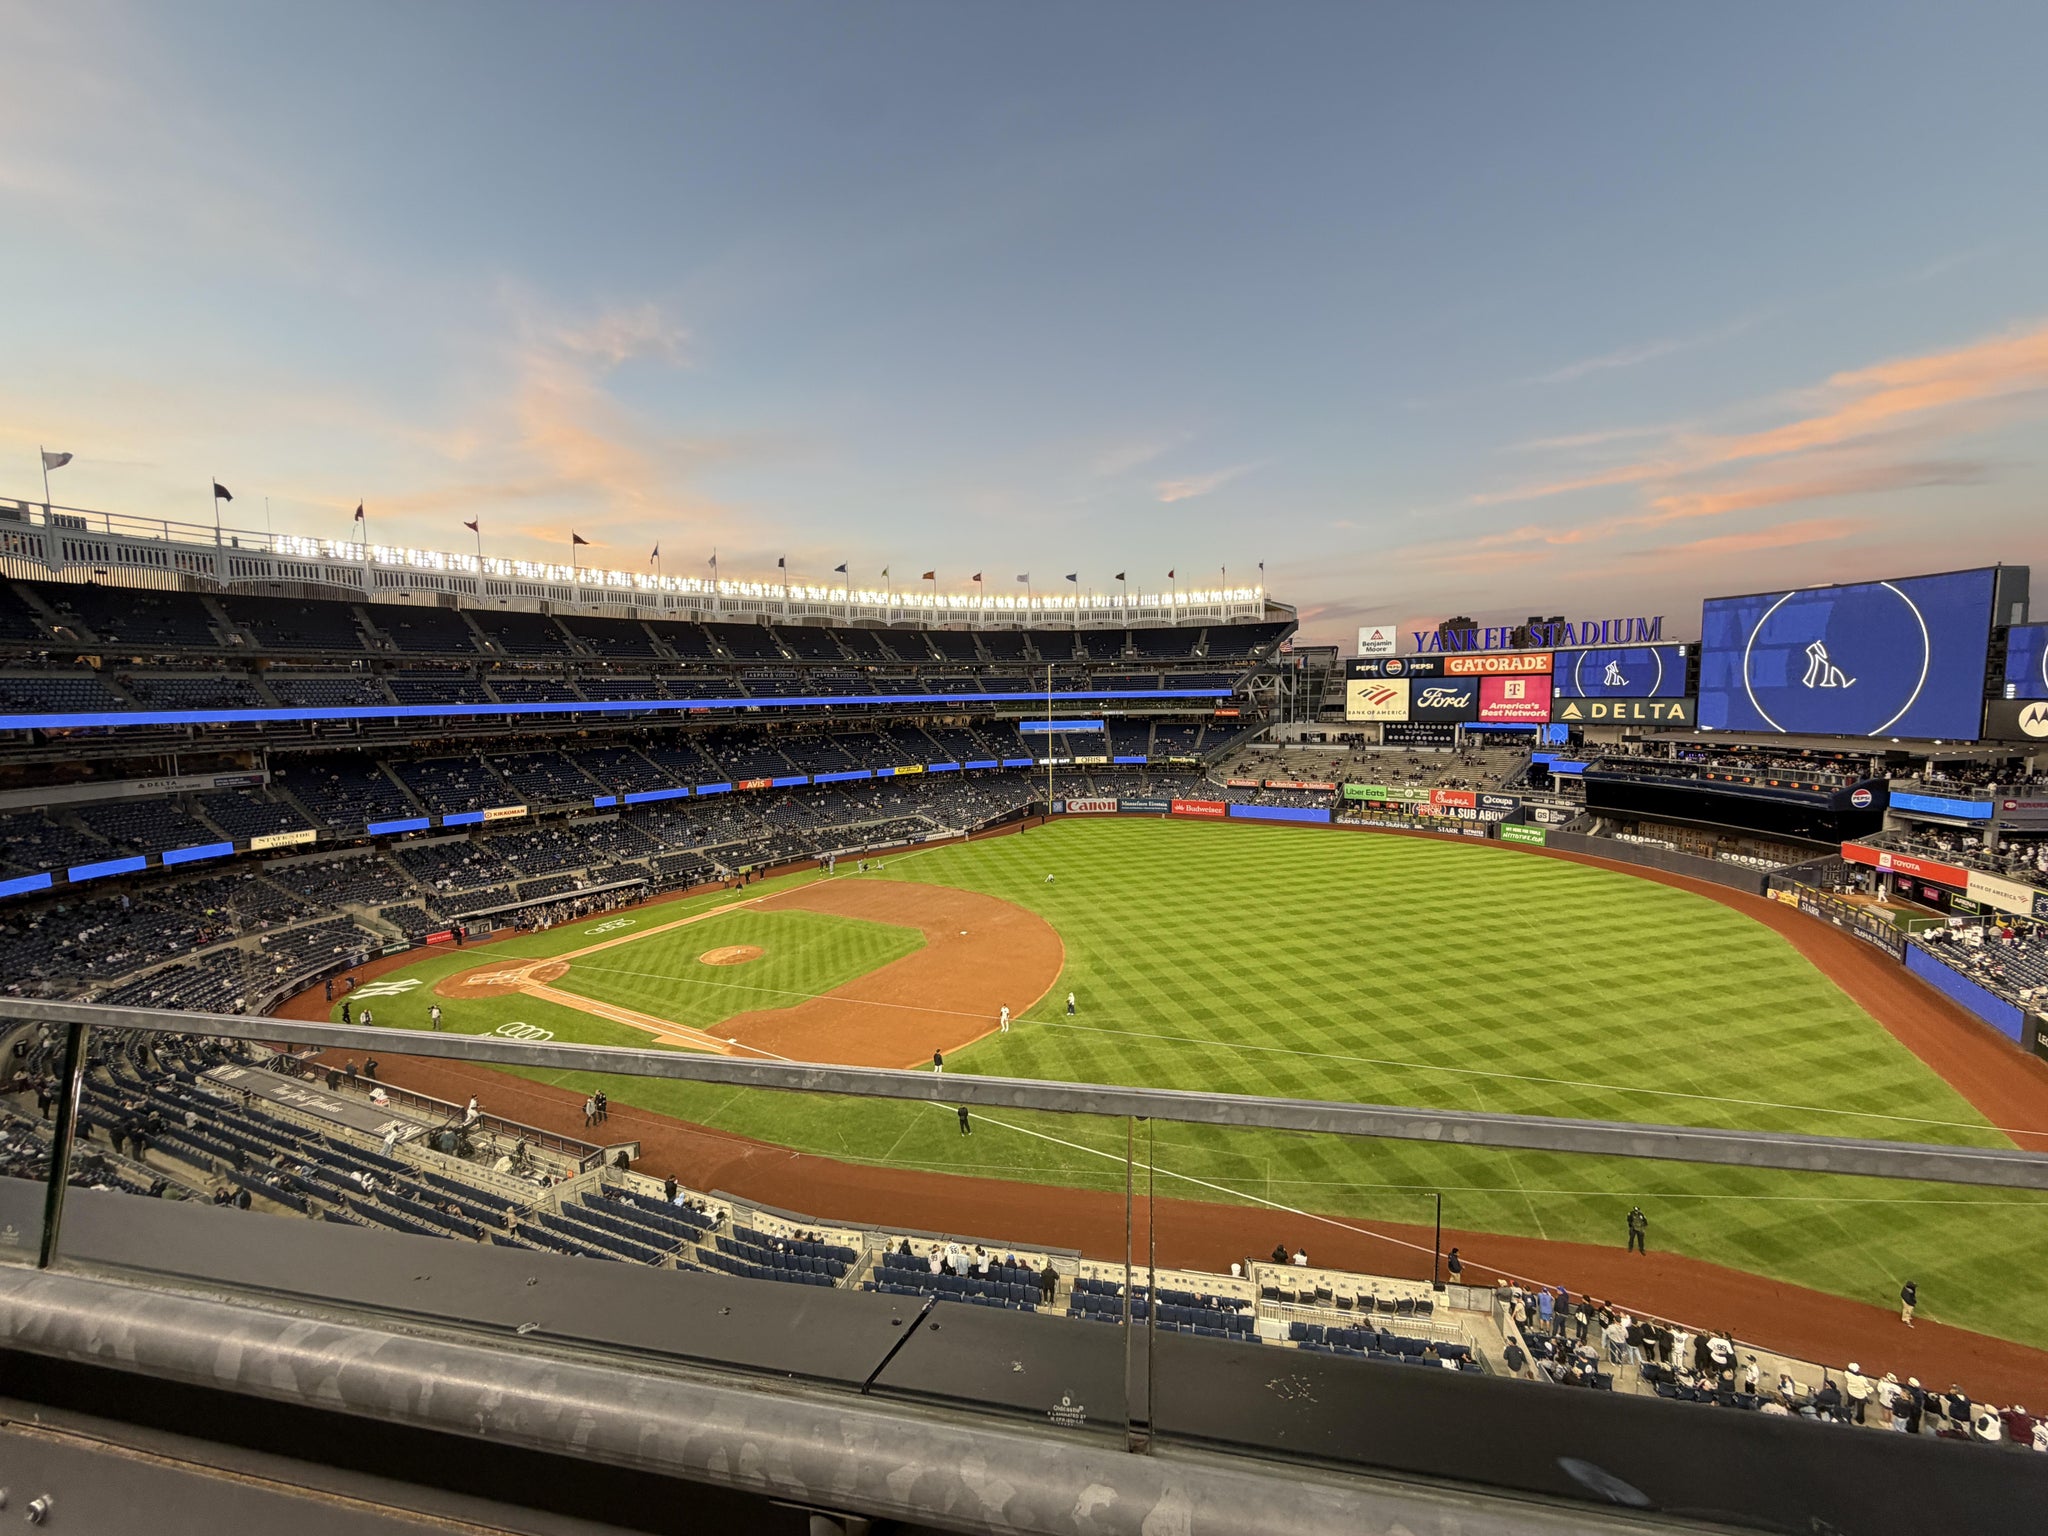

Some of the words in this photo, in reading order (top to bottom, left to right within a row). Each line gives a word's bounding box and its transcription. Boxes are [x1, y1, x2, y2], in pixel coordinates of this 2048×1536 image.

[1412, 626, 1513, 652] YANKEE
[1529, 616, 1664, 648] STADIUM
[1450, 656, 1547, 673] GATORADE
[1417, 687, 1472, 708] Ford
[1489, 702, 1539, 710] America's
[1481, 709, 1502, 717] Best
[1504, 709, 1549, 717] Network
[1591, 703, 1686, 720] DELTA
[747, 780, 765, 788] AVIS
[1346, 788, 1364, 796] Uber
[1366, 789, 1385, 797] Eats
[1068, 800, 1116, 811] Canon
[1492, 797, 1513, 806] coupa
[1186, 805, 1222, 814] Budweiser
[1458, 808, 1477, 820] SUB
[1438, 826, 1458, 834] STARR
[1893, 859, 1921, 872] TOYOTA
[1992, 890, 2017, 900] AMERICA
[1802, 902, 1820, 917] STARR
